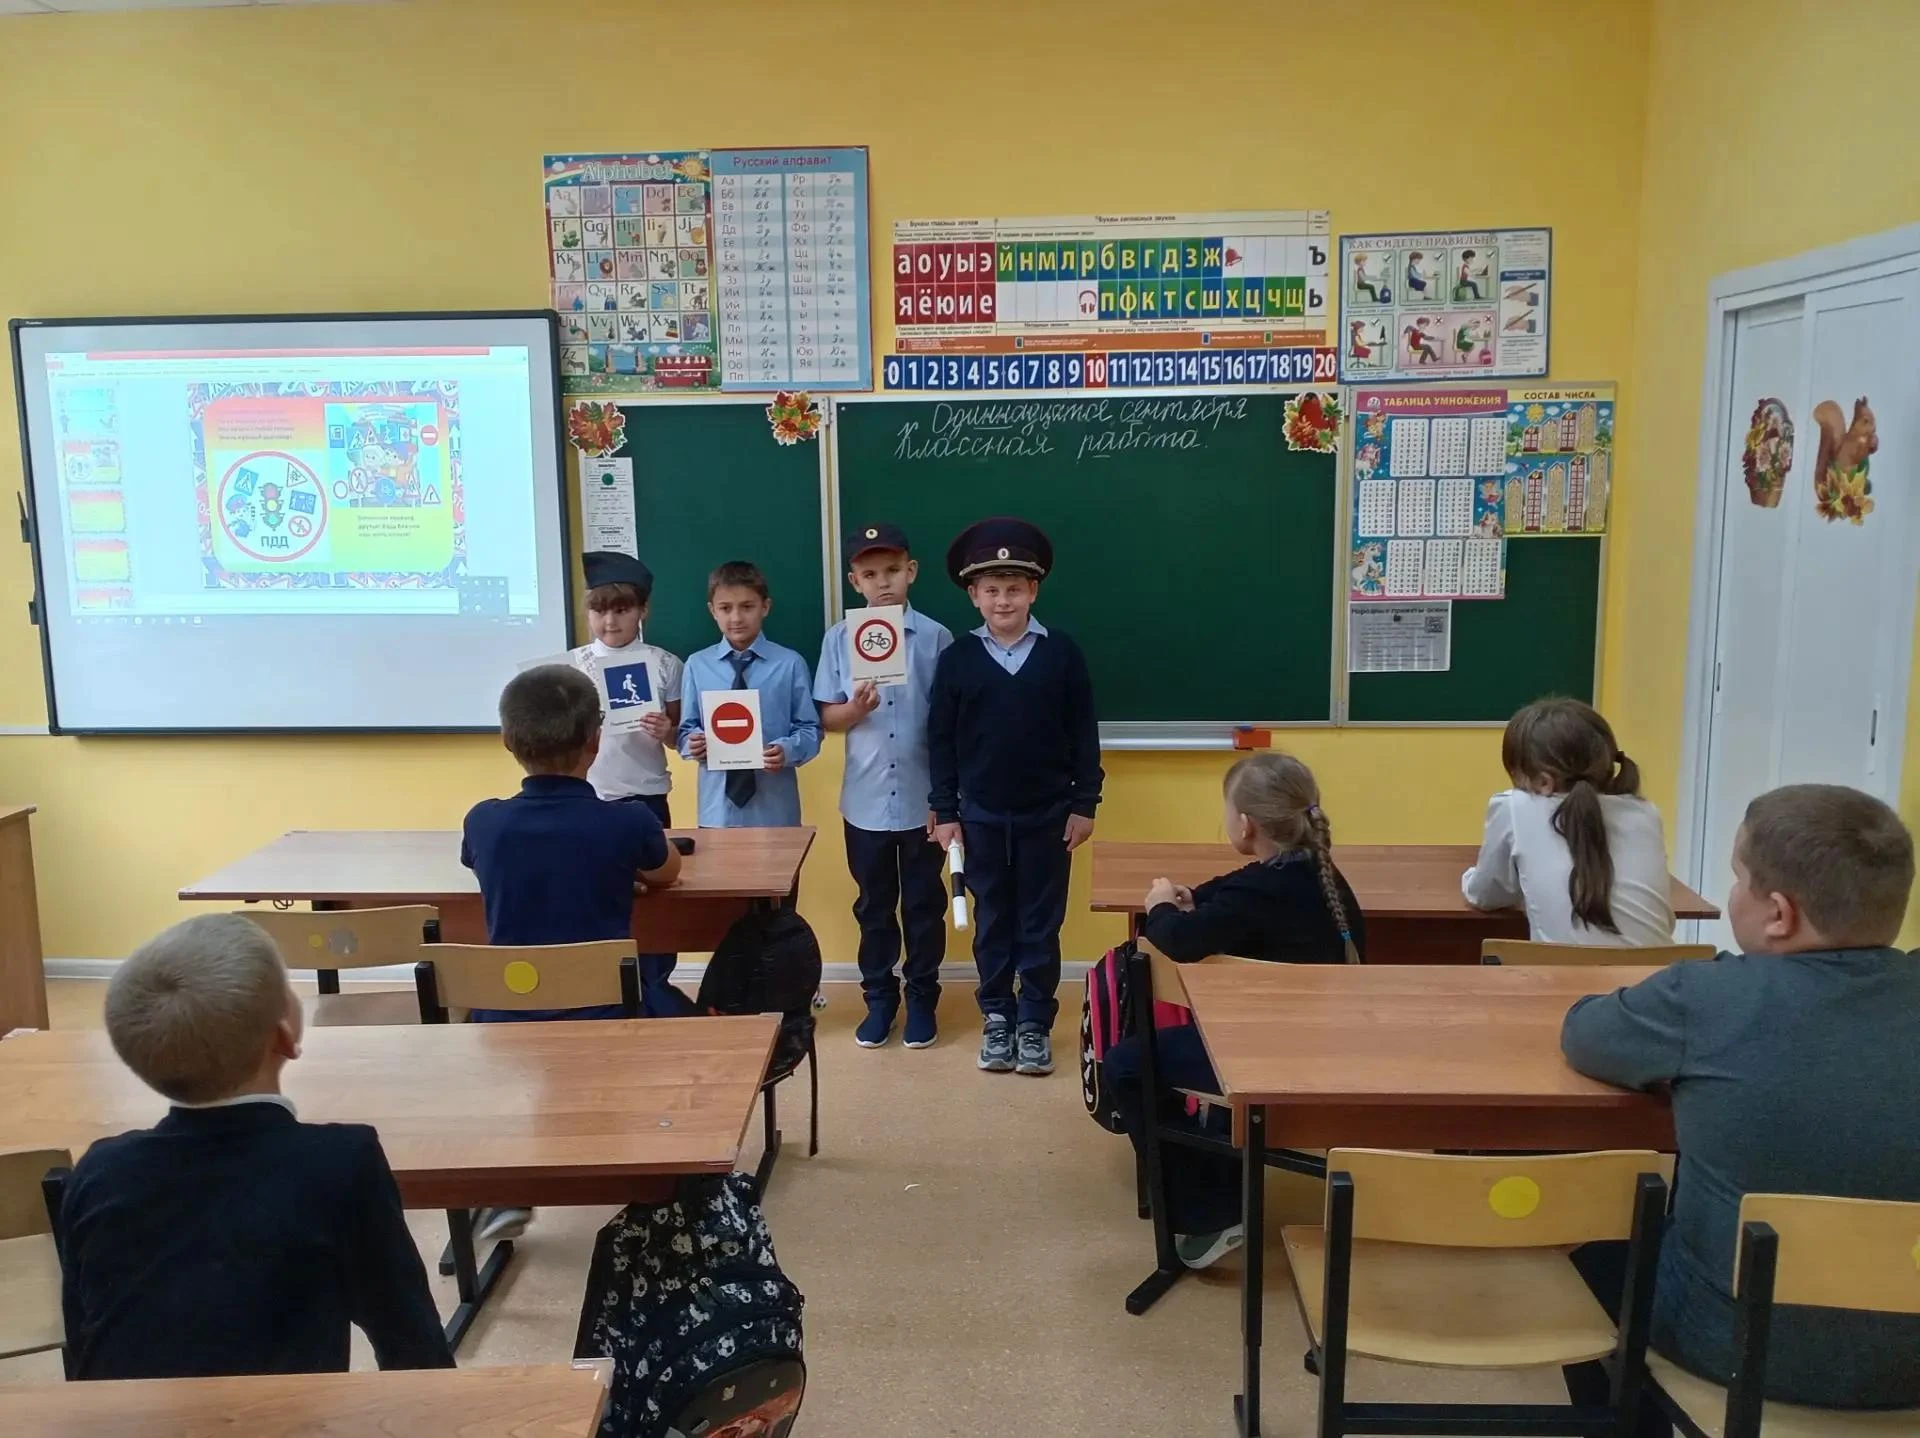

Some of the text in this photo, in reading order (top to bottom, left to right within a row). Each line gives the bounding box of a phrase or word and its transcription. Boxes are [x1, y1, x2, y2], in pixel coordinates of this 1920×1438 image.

[733, 156, 833, 168] Русский алфавит
[581, 160, 674, 182] Alphabet
[646, 186, 665, 198] Dd
[678, 186, 696, 197] Ee
[721, 189, 734, 198] Бб
[553, 220, 567, 232] Ff
[584, 220, 604, 235] Gg
[616, 219, 635, 231] Hh
[679, 217, 692, 232] Jj
[791, 222, 810, 233] Фф
[1350, 235, 1498, 249] КАК СИДЕТЬ ПРАВИЛЬНО
[557, 250, 699, 264] Kk Ll Mm Nn Oo
[898, 254, 911, 274] а
[918, 253, 932, 273] о
[939, 252, 952, 281] у
[957, 252, 974, 272] ы
[980, 251, 993, 271] э
[1000, 245, 1013, 272] й
[1020, 251, 1033, 271] н
[1038, 251, 1056, 270] м
[1061, 250, 1075, 270] л
[1081, 250, 1095, 277] р
[1101, 243, 1115, 270] б
[1121, 249, 1135, 270] в
[1144, 249, 1155, 268] г
[1162, 249, 1179, 273] д
[1185, 248, 1197, 268] з
[1203, 247, 1221, 267] ж
[722, 264, 740, 272] Жж
[588, 284, 607, 297] Qq
[620, 284, 634, 295] Rr
[652, 284, 668, 294] Ss
[682, 283, 695, 294] Tt
[899, 296, 912, 316] я
[919, 288, 932, 315] ё
[937, 295, 954, 315] ю
[959, 295, 972, 314] и
[980, 294, 993, 314] е
[1101, 292, 1114, 312] п
[1120, 285, 1137, 318] ф
[1142, 291, 1156, 311] к
[1164, 291, 1177, 311] т
[1185, 290, 1196, 311] с
[1203, 290, 1220, 309] ш
[1226, 289, 1239, 309] х
[1246, 289, 1260, 313] ц
[1268, 288, 1281, 308] ч
[1286, 288, 1304, 312] щ
[559, 316, 577, 327] Uu
[591, 316, 608, 327] Vv
[621, 315, 640, 327] Ww
[653, 314, 671, 325] Xx
[727, 313, 739, 321] Кк
[561, 348, 576, 360] Zz
[728, 348, 741, 357] Нн
[728, 361, 742, 369] Оо
[887, 353, 1336, 385] 0 1 2 3 4 5 6 7 8 9 10 11 12 13 14 15 16 17 18 19 20
[1384, 396, 1501, 407] ТАБЛИЦА УМНОЖЕНИЯ
[1524, 391, 1596, 400] СОСТАВ ЧИСЛА
[1120, 397, 1248, 431] сентября
[894, 421, 1055, 459] Классная
[261, 536, 289, 549] ПДД
